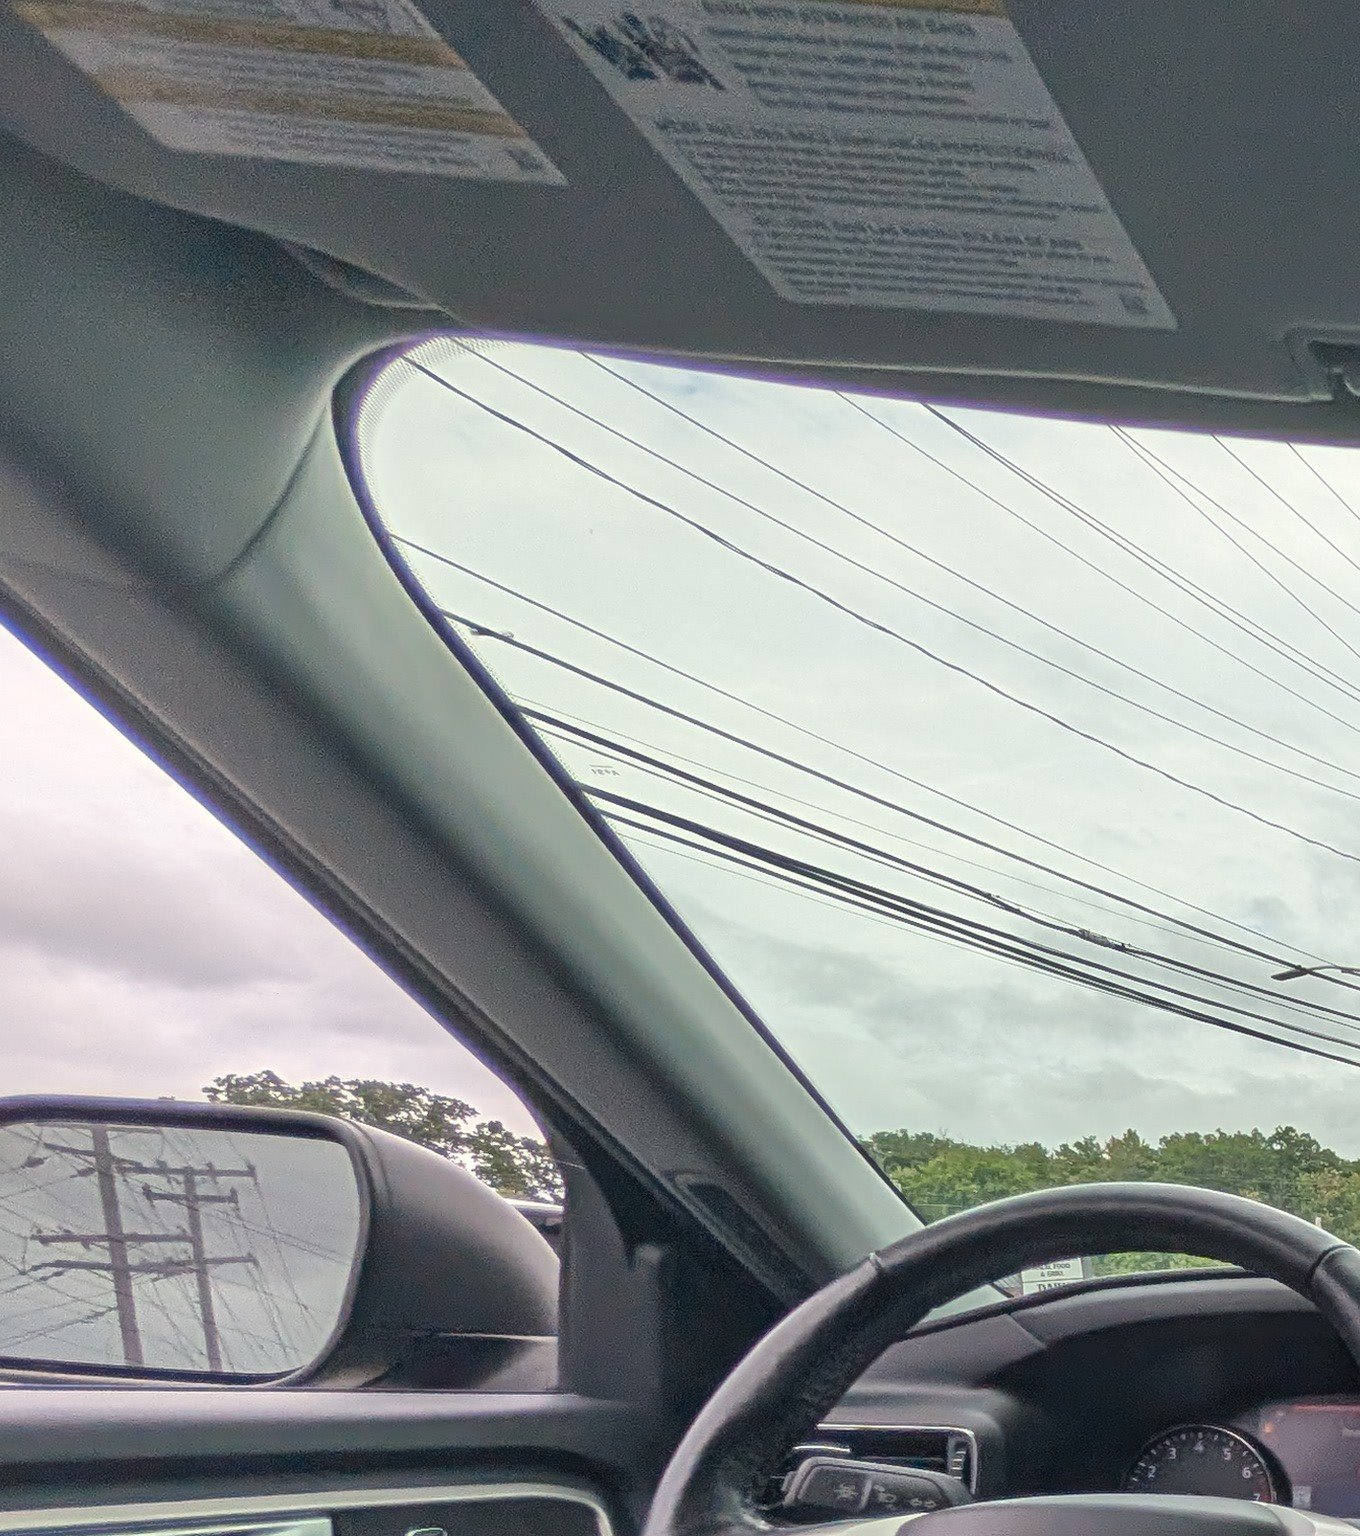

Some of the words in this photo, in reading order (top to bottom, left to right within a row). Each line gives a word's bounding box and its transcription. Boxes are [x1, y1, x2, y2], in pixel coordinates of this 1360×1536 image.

[1168, 1448, 1176, 1460] 3
[1223, 1448, 1232, 1461] 5
[1241, 1467, 1251, 1479] 6
